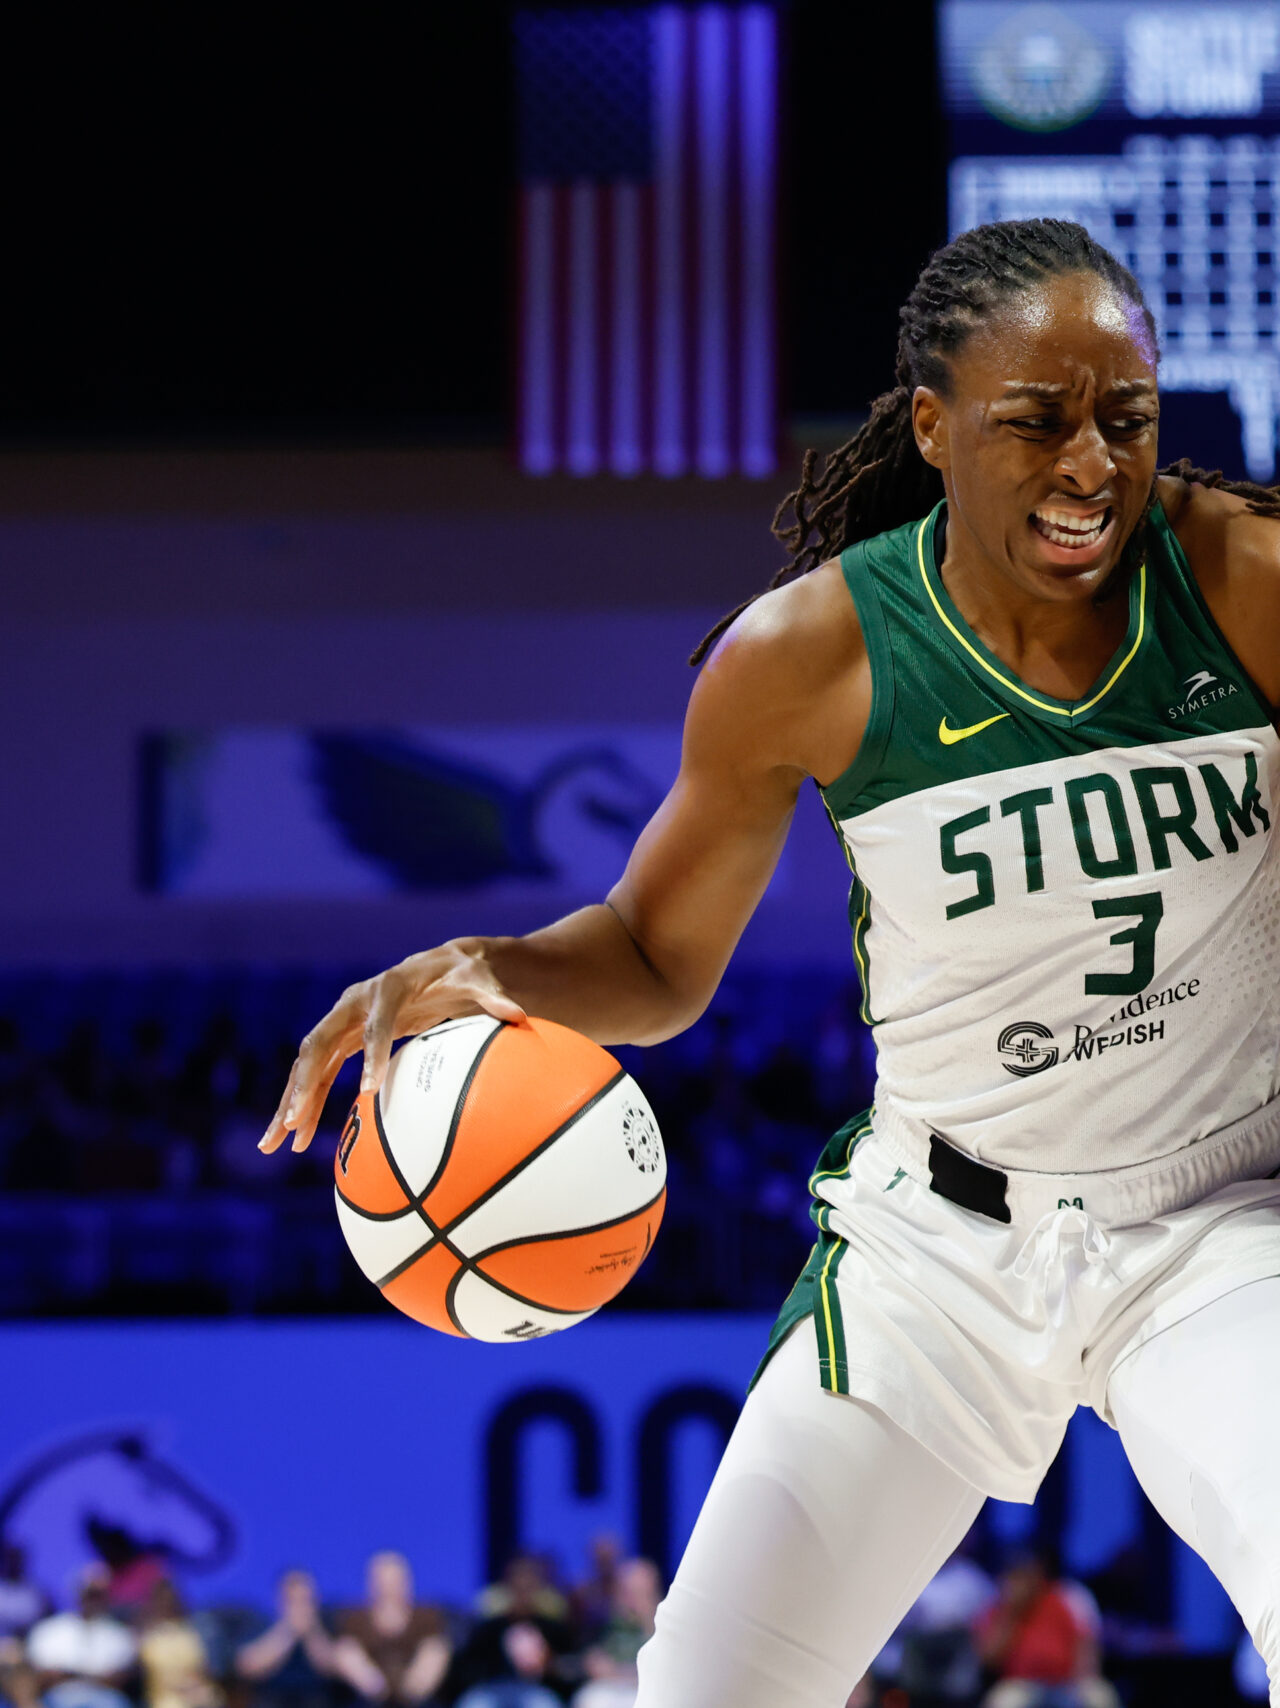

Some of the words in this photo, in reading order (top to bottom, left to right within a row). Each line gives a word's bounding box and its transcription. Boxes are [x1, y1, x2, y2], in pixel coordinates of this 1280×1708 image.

[1168, 683, 1238, 719] SYMETRA
[940, 751, 1271, 921] STORM
[1084, 891, 1164, 997] 3
